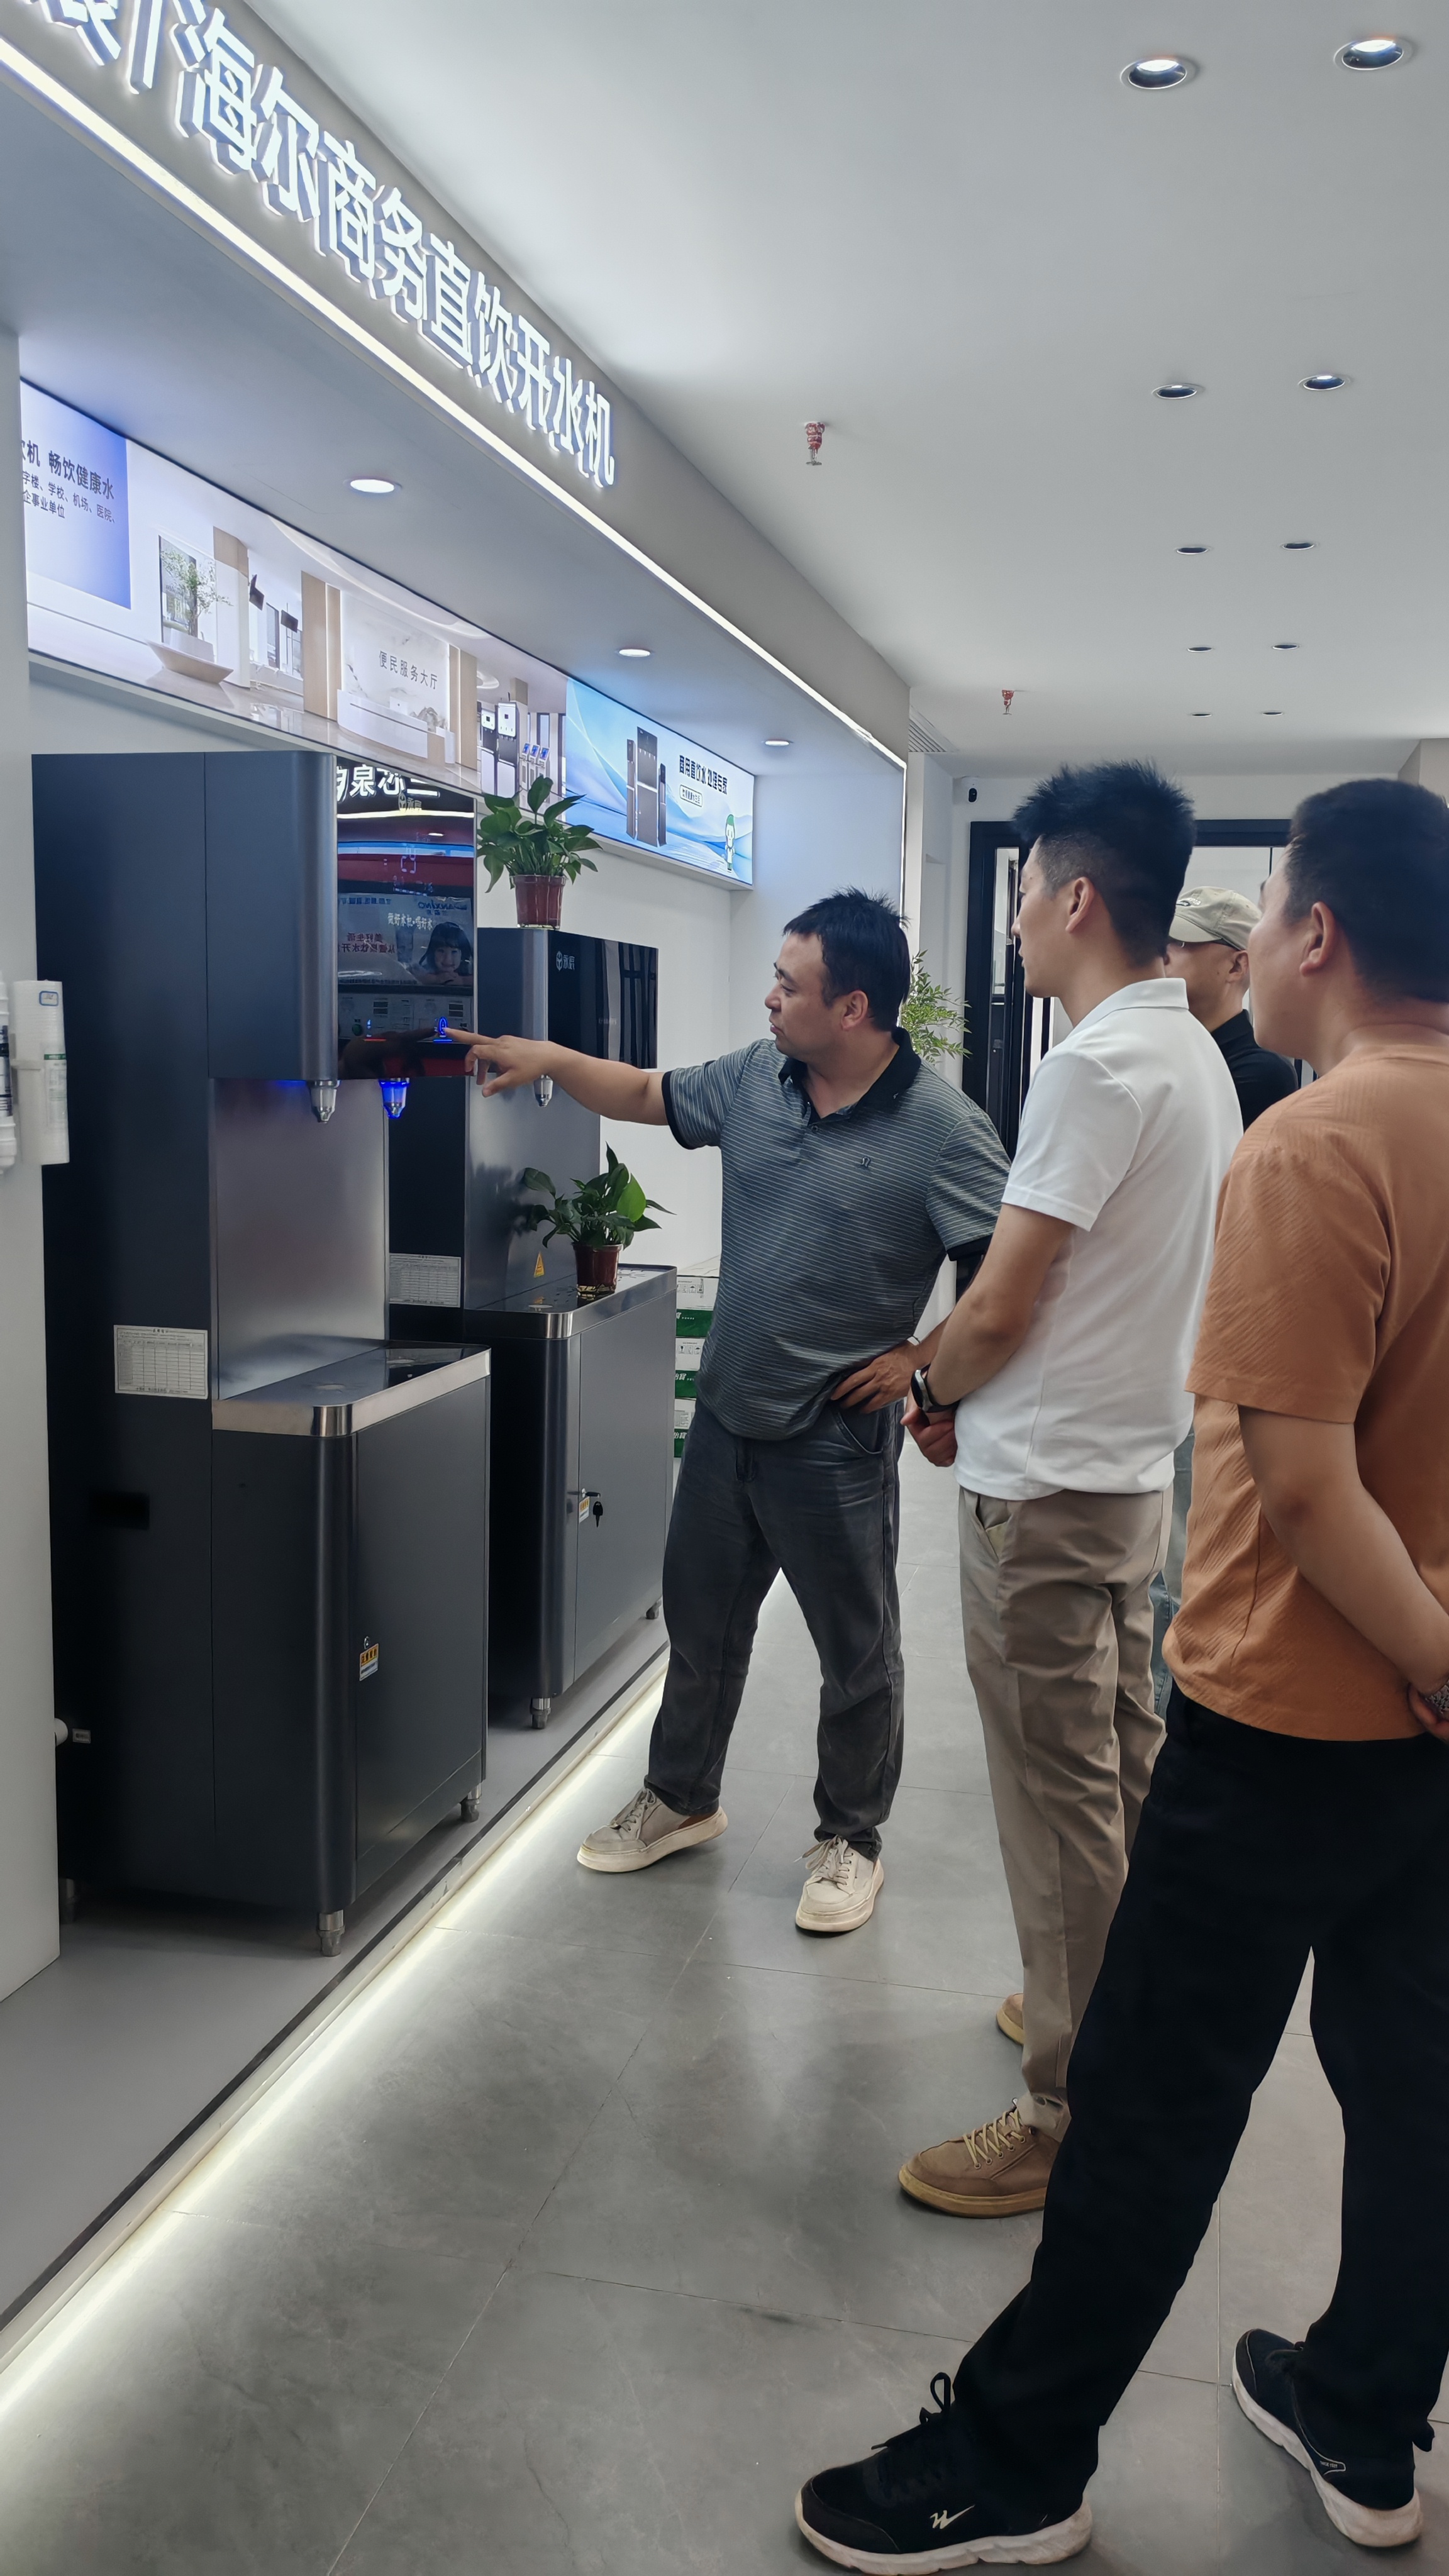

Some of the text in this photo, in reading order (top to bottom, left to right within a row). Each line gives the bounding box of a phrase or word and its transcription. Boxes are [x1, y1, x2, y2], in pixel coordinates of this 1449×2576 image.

[171, 0, 616, 488] 海尔商务直饮开水机
[48, 450, 114, 500] 畅饮健康水
[23, 489, 65, 519] 企事业单位
[379, 650, 438, 690] 便民服务大厅
